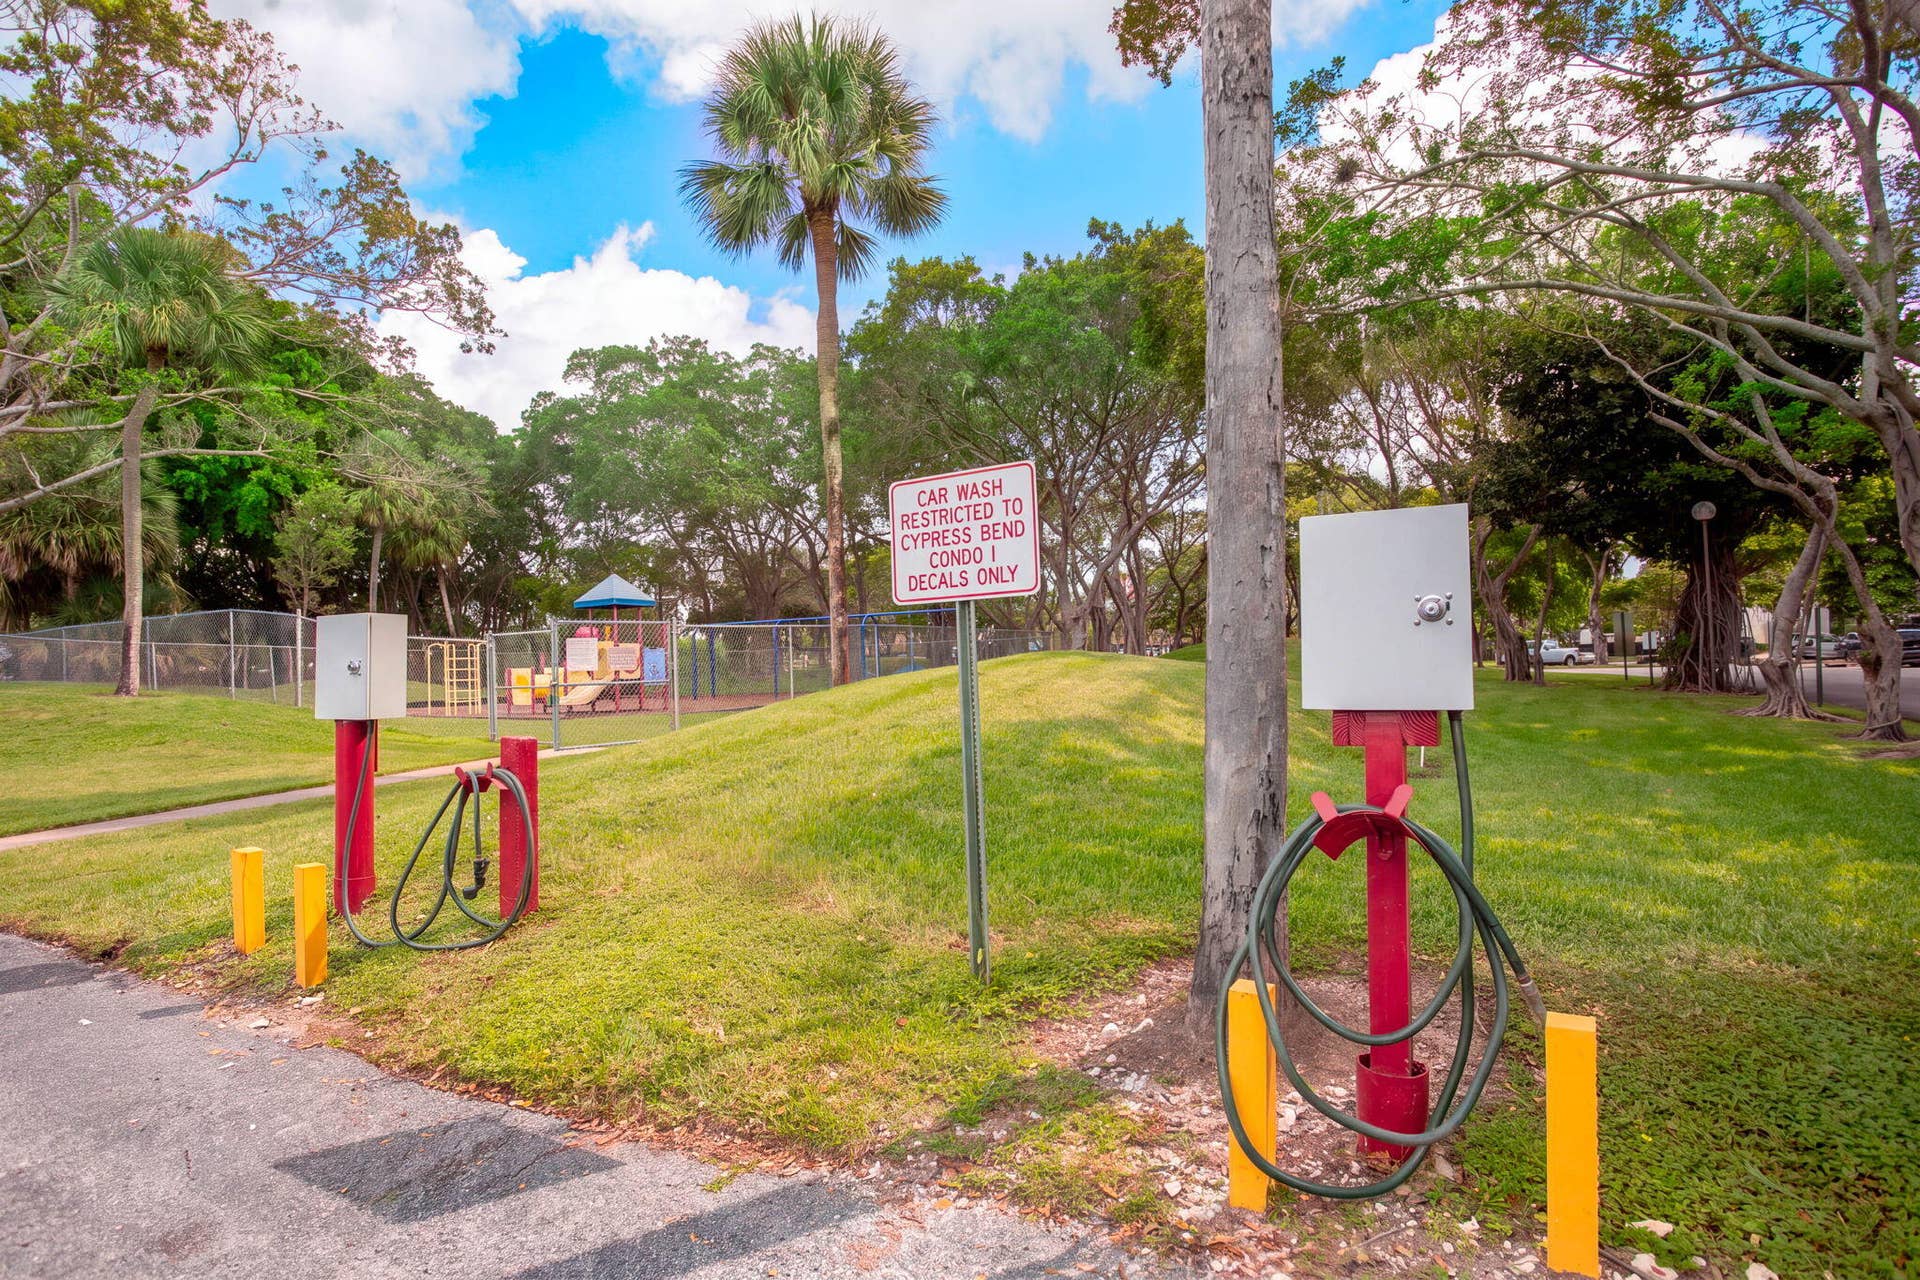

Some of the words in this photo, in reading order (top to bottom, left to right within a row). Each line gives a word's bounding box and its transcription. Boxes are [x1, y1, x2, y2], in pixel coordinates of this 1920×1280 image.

[917, 487, 948, 507] CAR
[956, 478, 1003, 501] WASH
[900, 502, 994, 531] RESTRICTED
[1002, 497, 1023, 516] TO
[901, 526, 972, 551] CYPRESS
[980, 520, 1025, 541] BEND
[929, 546, 983, 569] CONDO
[908, 569, 969, 592] DECALS
[977, 564, 1019, 585] ONLY
